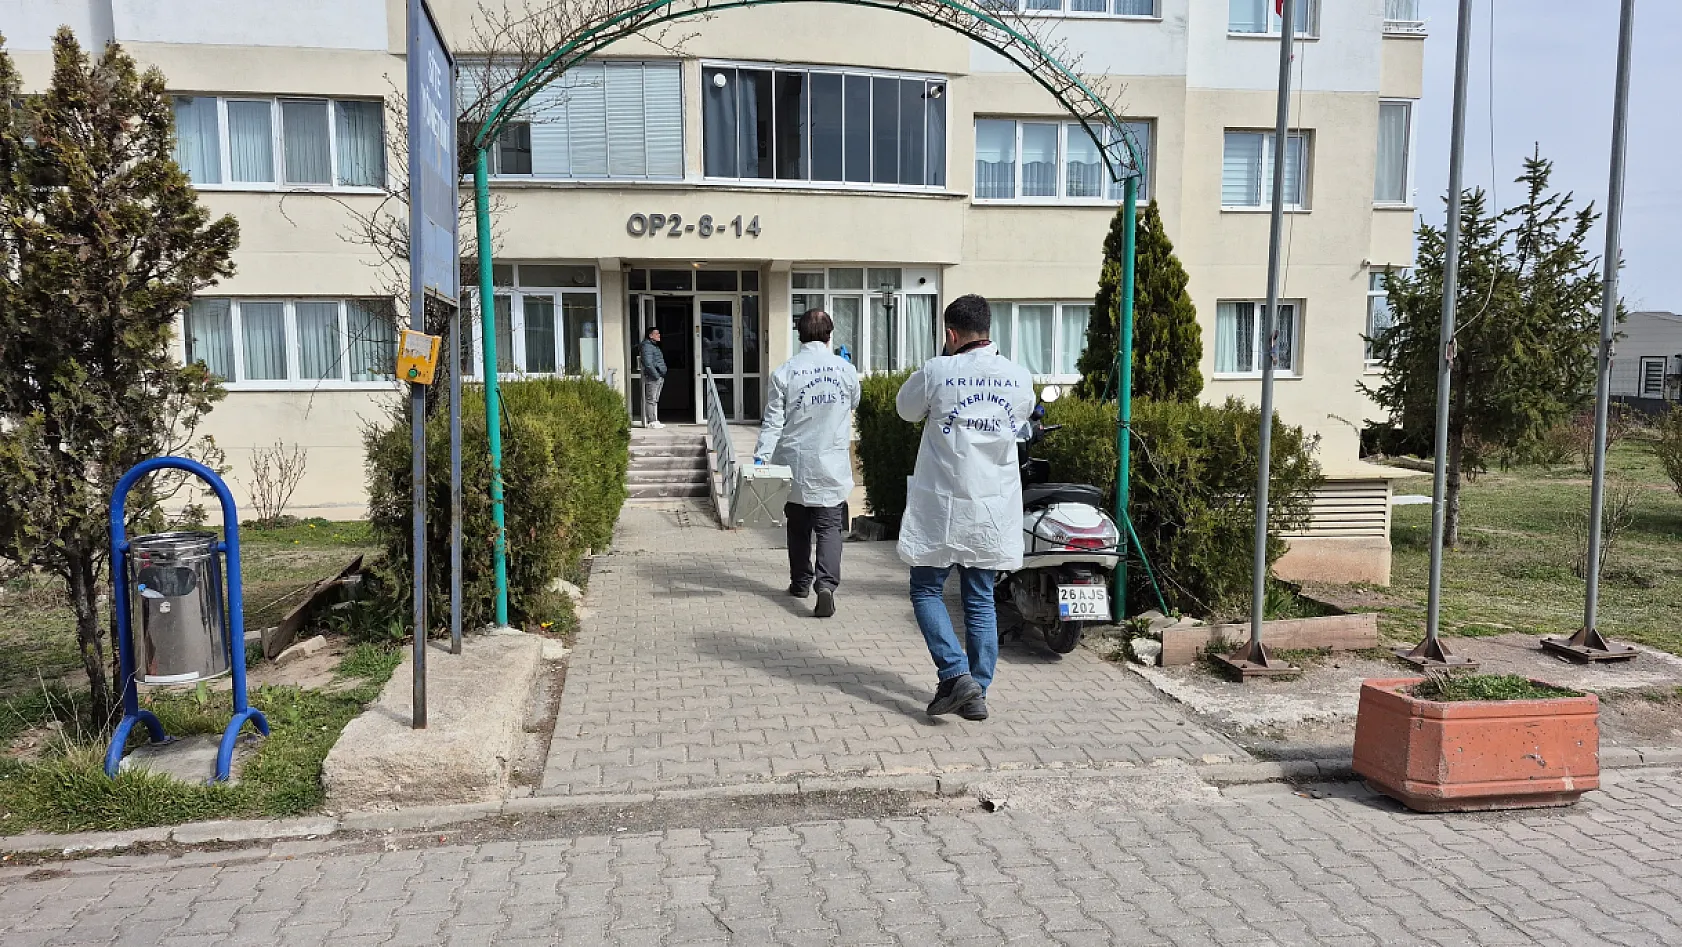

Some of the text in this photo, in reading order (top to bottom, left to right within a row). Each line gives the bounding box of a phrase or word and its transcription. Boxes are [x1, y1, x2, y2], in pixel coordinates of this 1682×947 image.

[626, 213, 762, 238] OP2-8-14
[942, 406, 959, 435] OLAY
[1071, 602, 1096, 614] 202
